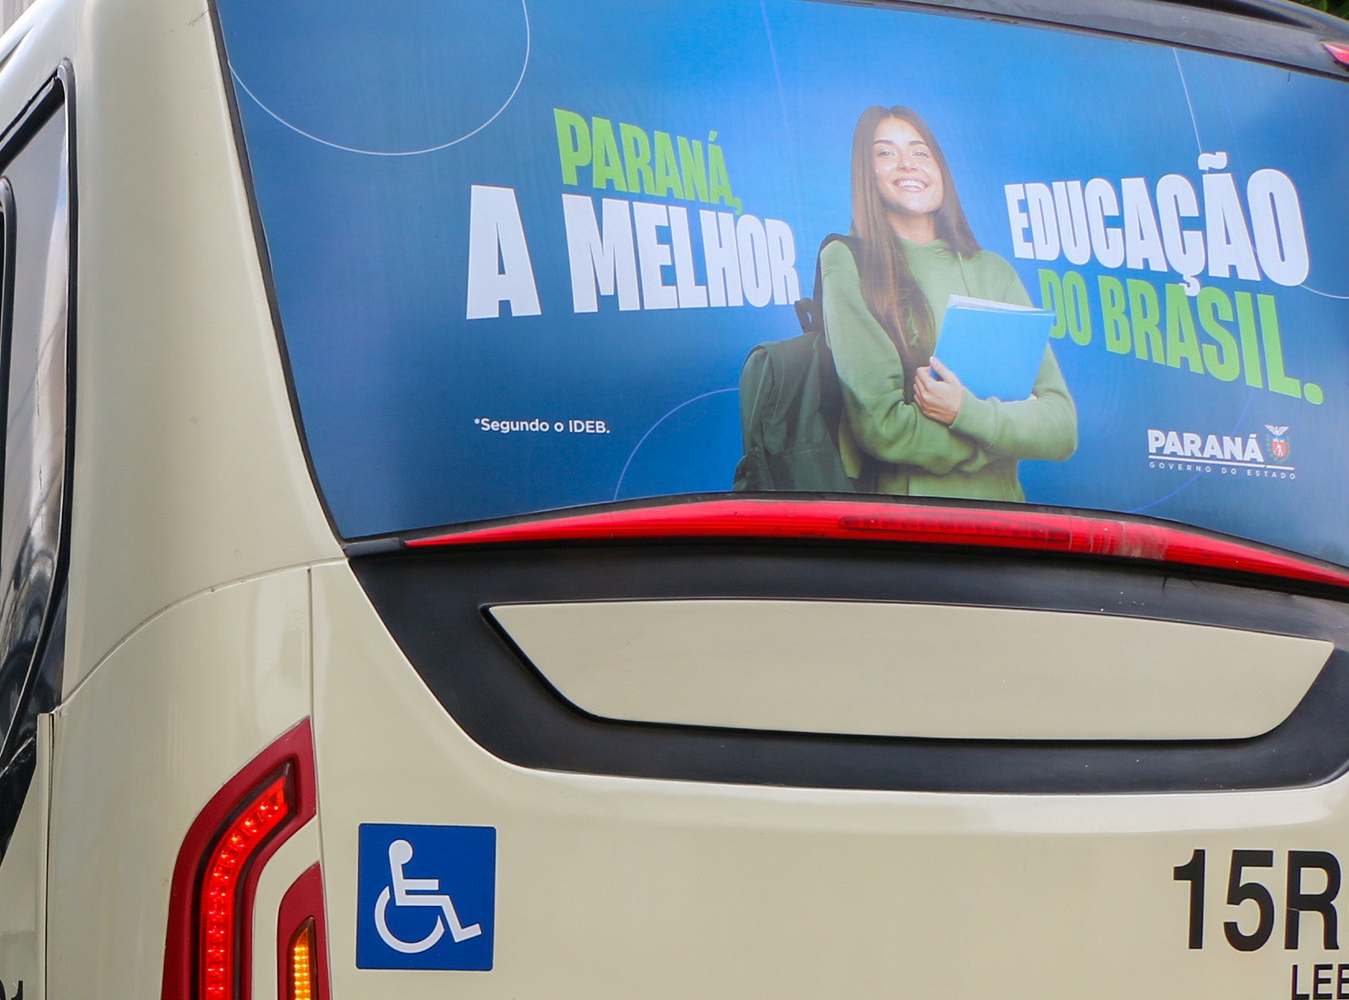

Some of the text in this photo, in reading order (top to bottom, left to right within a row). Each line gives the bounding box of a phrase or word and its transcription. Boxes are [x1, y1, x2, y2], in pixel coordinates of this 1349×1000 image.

[553, 108, 742, 215] PARANÁ,
[466, 184, 800, 319] A MELHOR
[1004, 151, 1311, 297] EDUCAÇÃO
[1038, 268, 1324, 405] DO BRASIL.
[554, 421, 564, 433] o
[569, 419, 611, 434] IDEB.
[1147, 428, 1265, 463] PARANÁ
[1149, 461, 1296, 480] GOVERNO DO ESTADO
[1173, 848, 1341, 952] 15R
